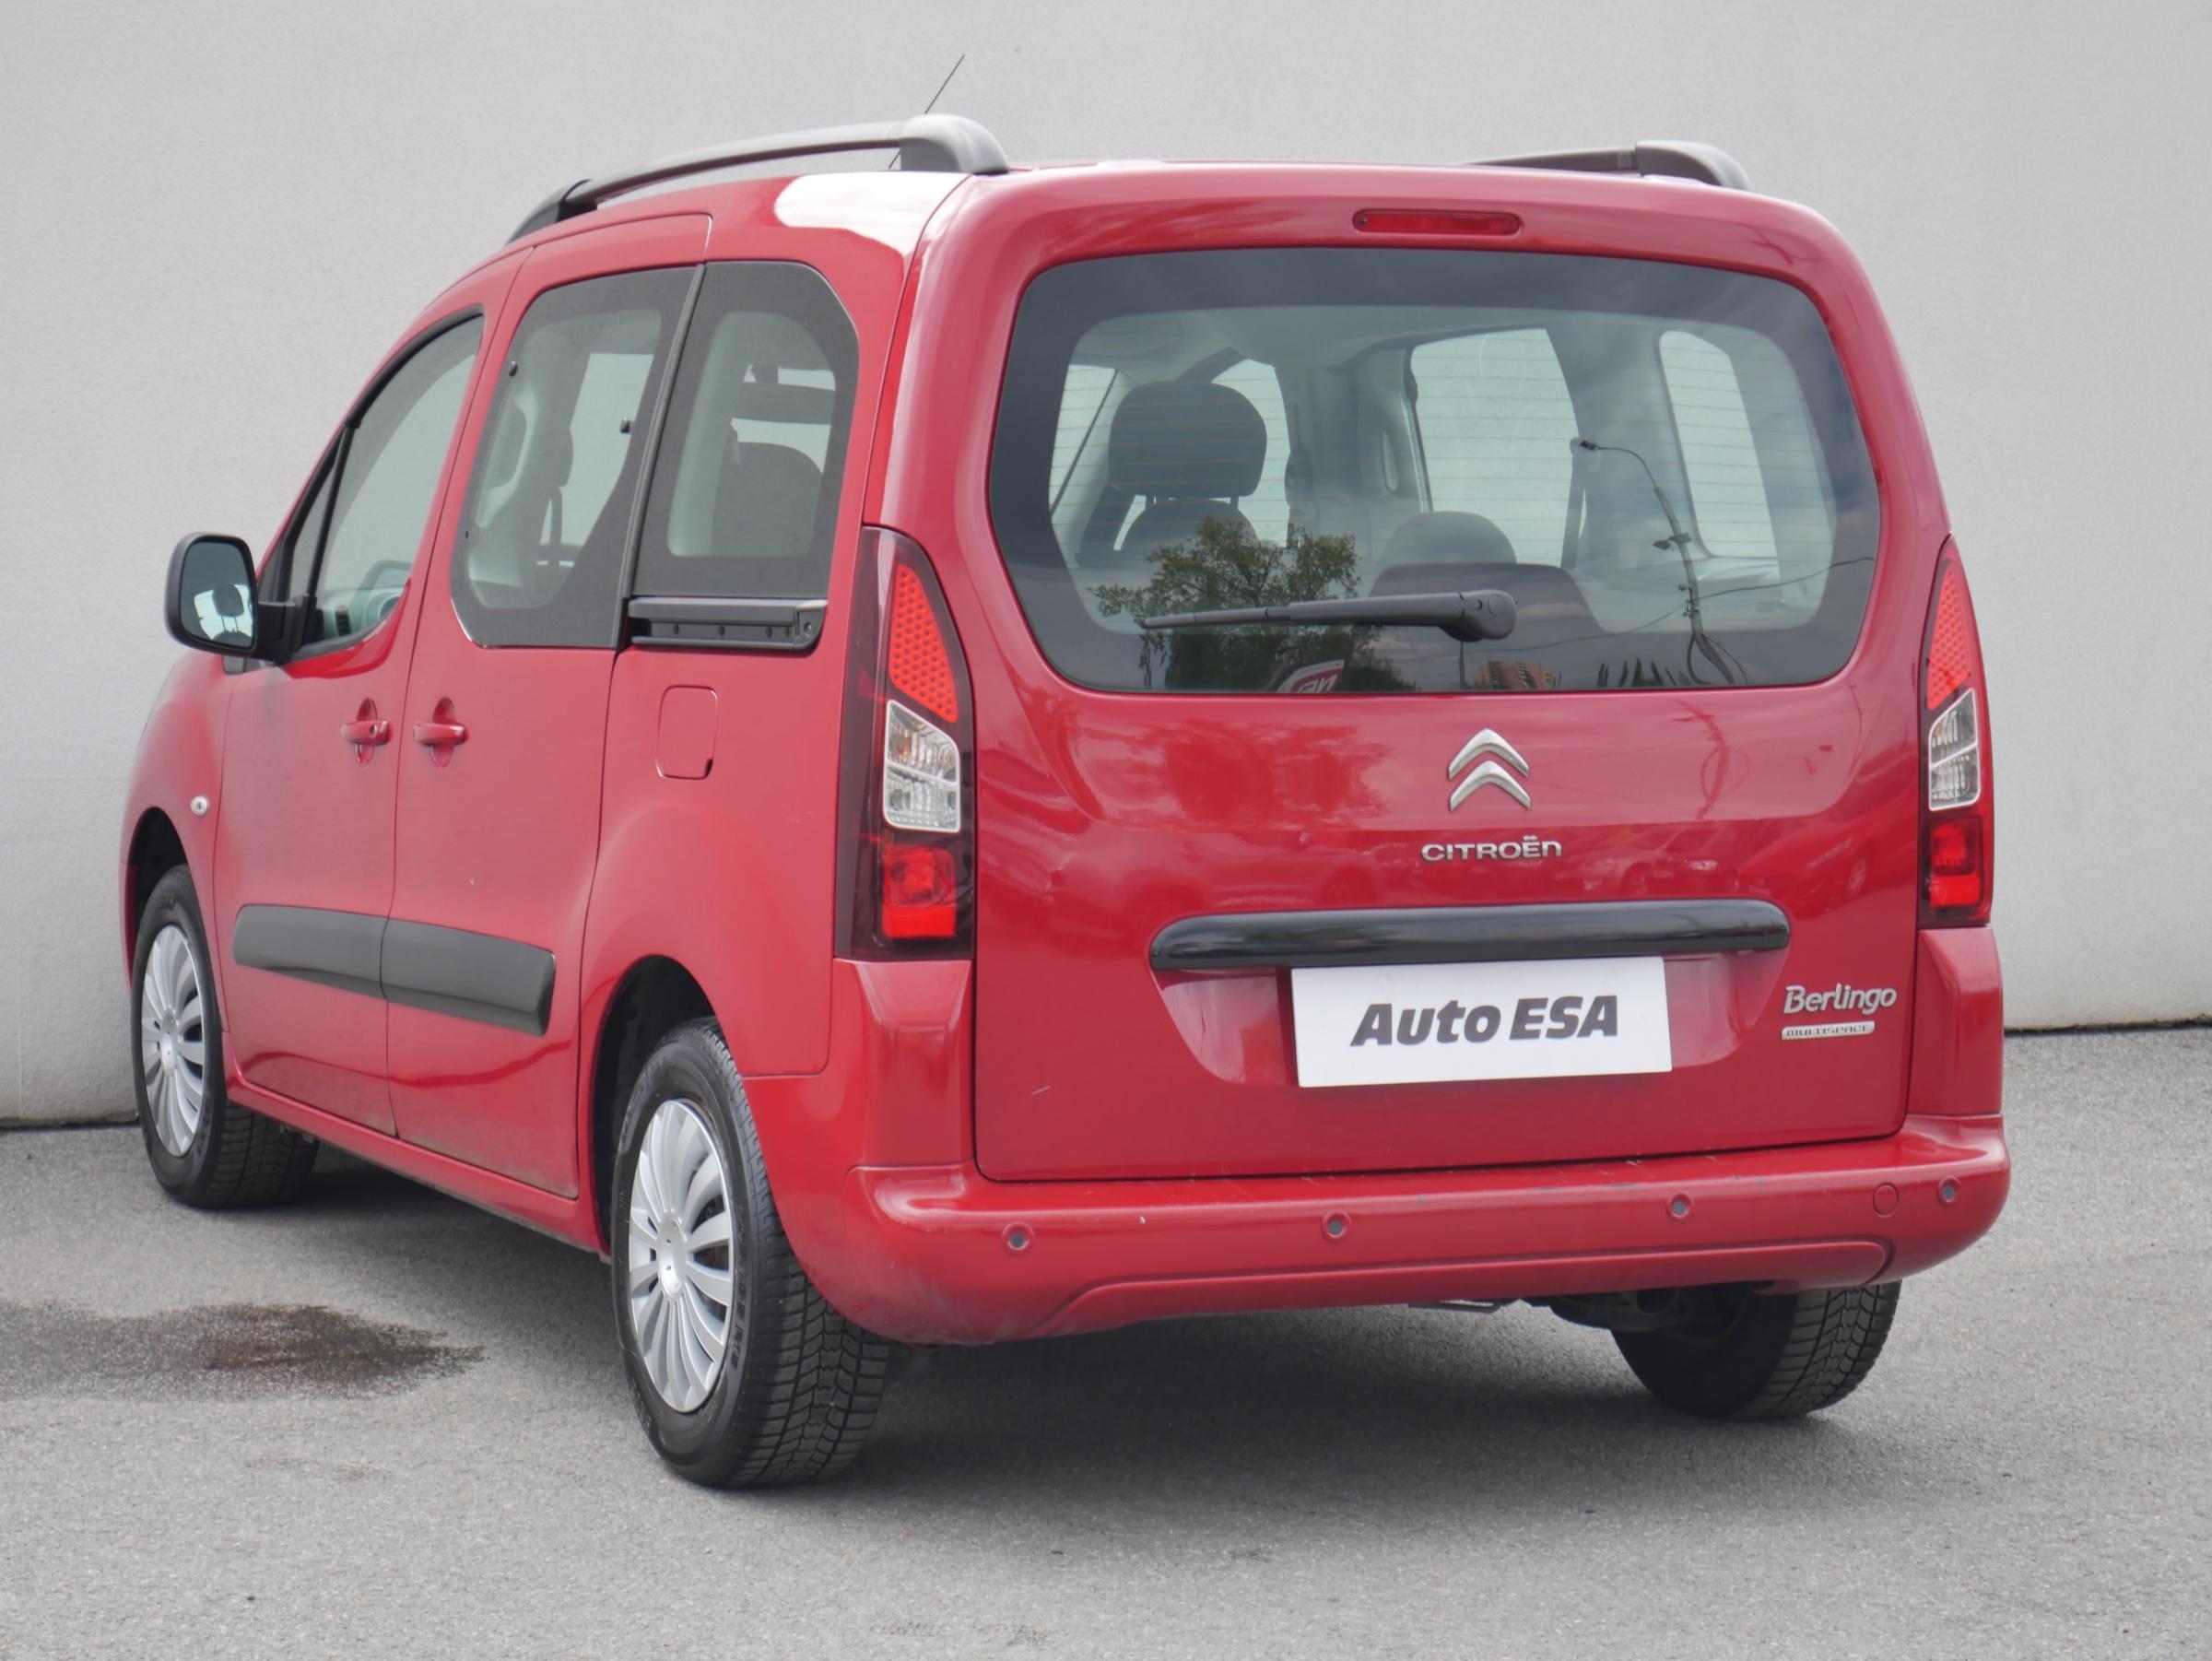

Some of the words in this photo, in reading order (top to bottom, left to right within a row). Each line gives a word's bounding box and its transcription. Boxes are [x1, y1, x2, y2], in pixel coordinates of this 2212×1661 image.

[1783, 983, 1897, 1015] Berlingo
[1350, 1000, 1501, 1046] Auto
[1510, 995, 1618, 1040] ESA
